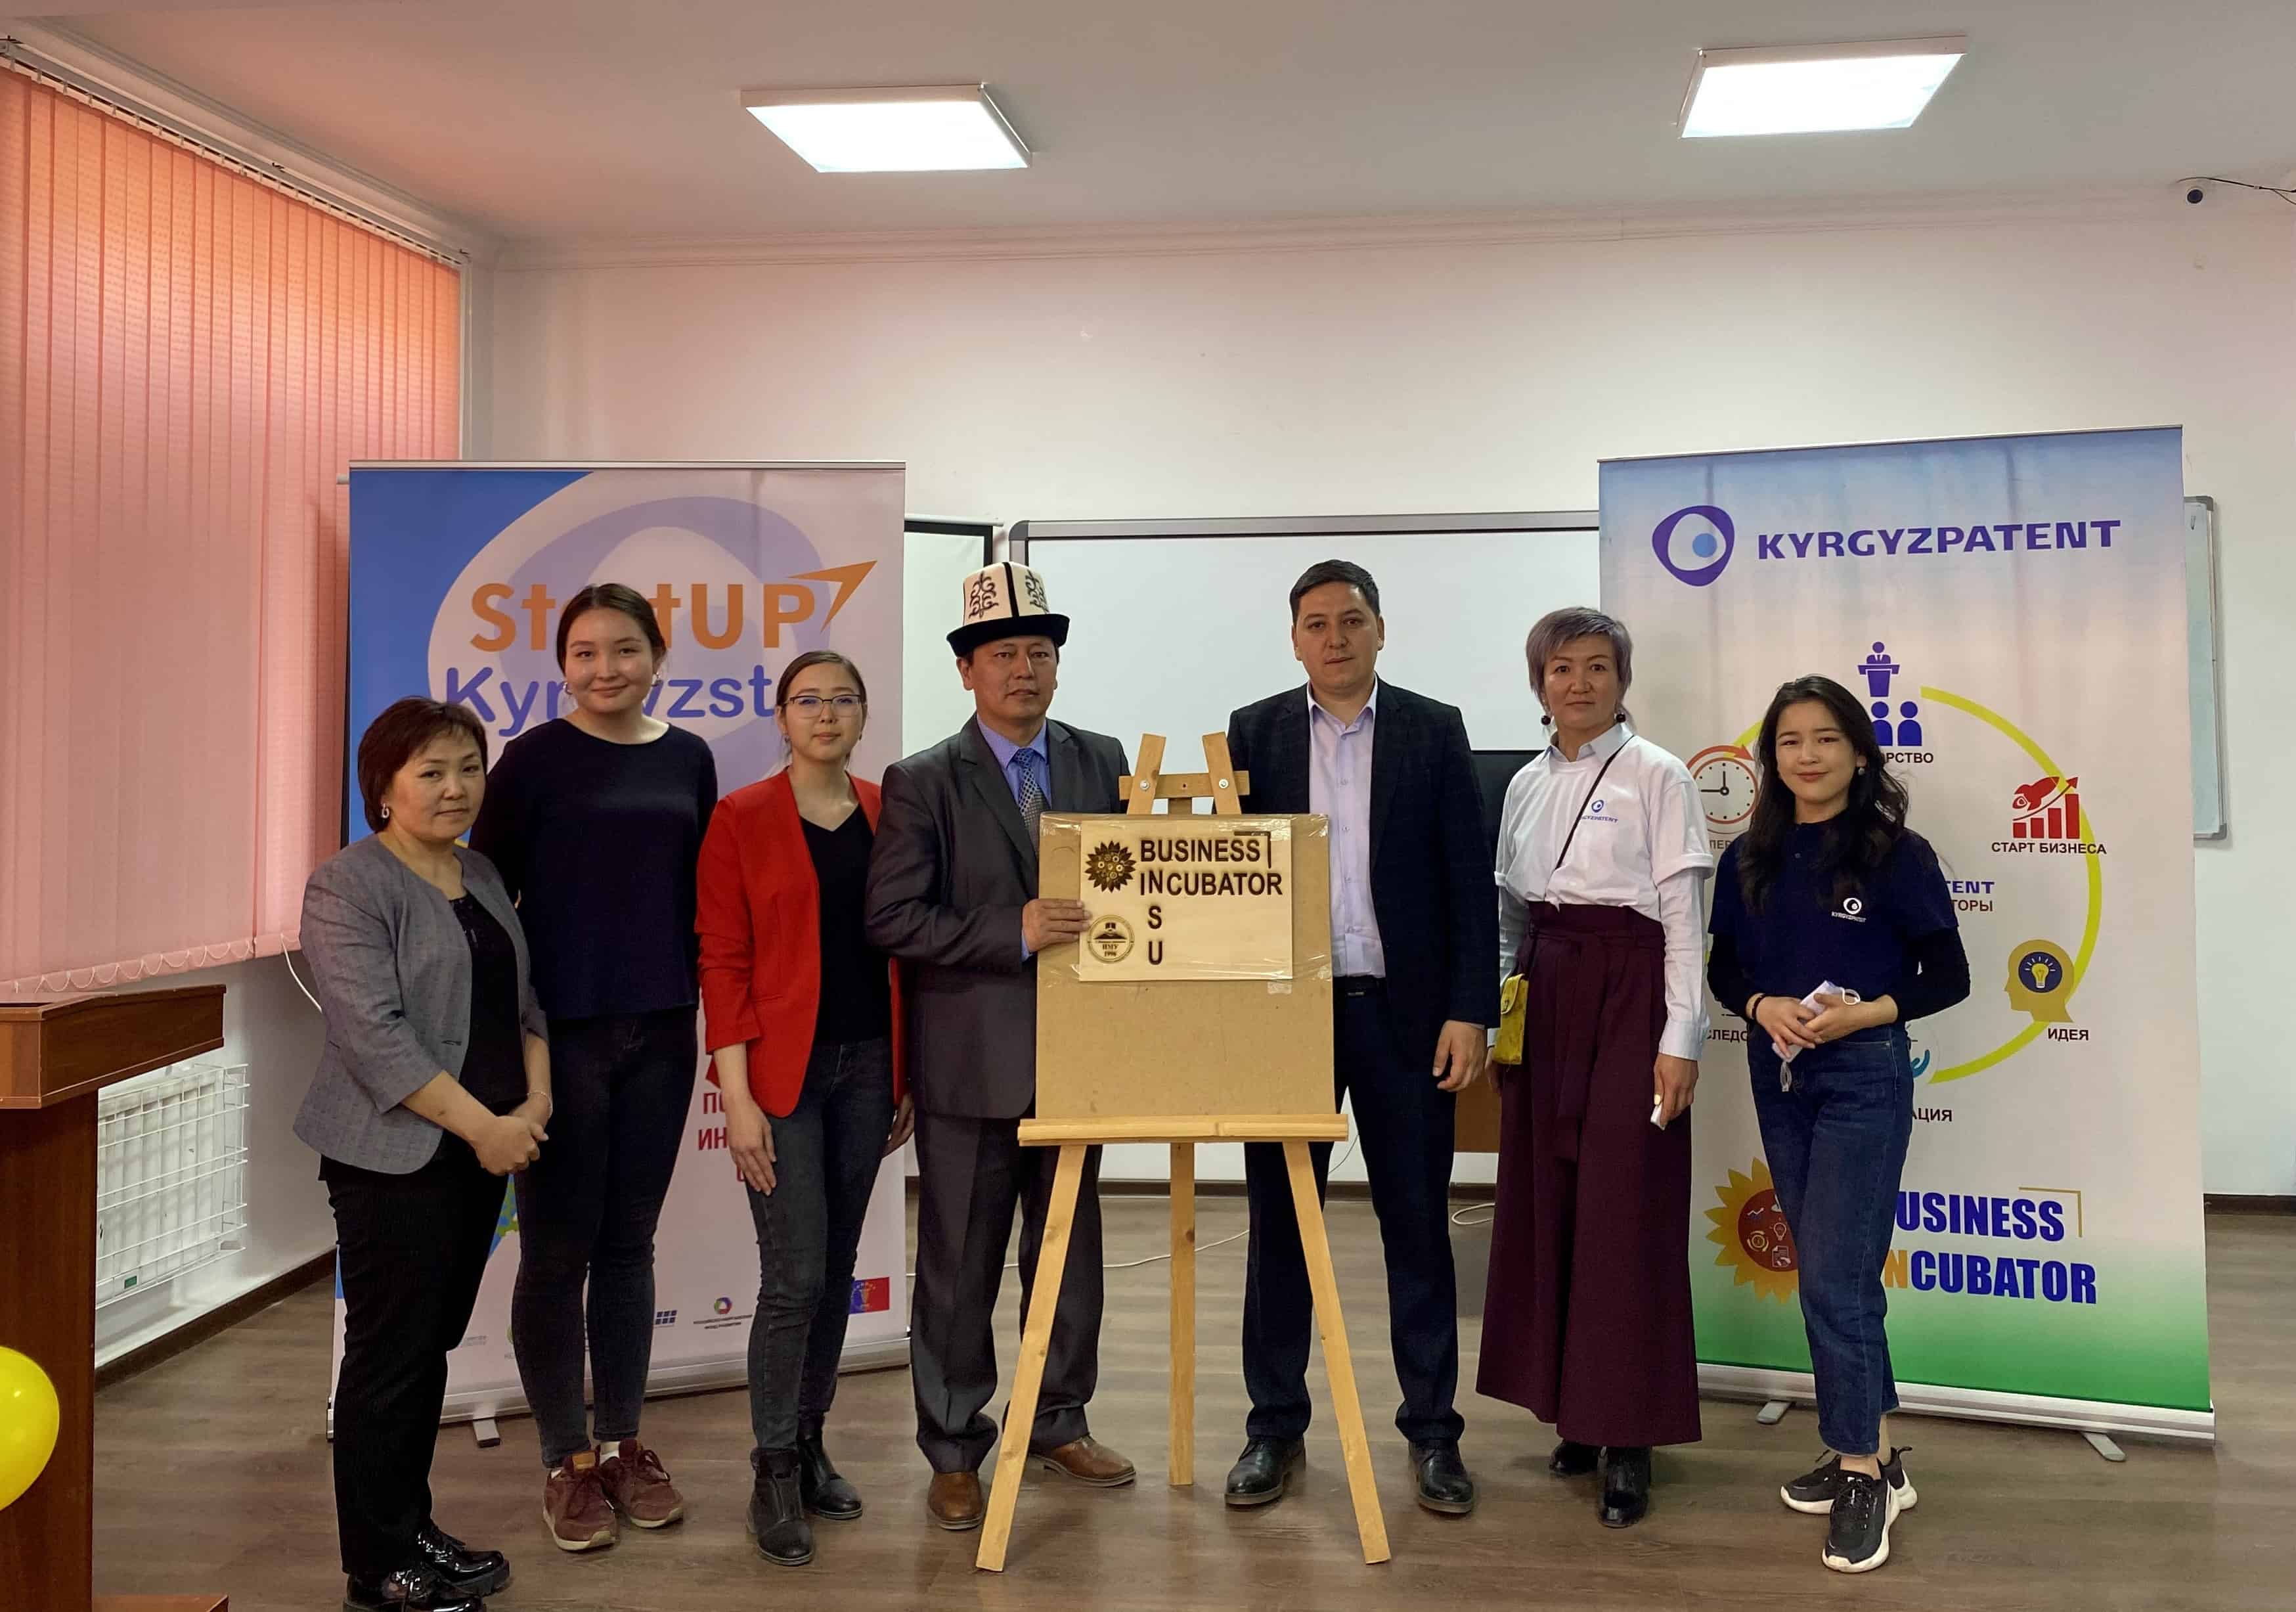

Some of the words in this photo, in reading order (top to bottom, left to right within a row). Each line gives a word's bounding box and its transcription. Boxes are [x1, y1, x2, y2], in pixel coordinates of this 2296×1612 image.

[1758, 520, 2121, 560] KYRGYZPATENT
[470, 583, 815, 652] SttUP
[1140, 839, 1261, 862] BUSINESS
[1991, 841, 2035, 853] СТАРТ
[2039, 843, 2107, 855] БИЗНЕСА
[1139, 870, 1283, 896] INCUBATOR
[1952, 899, 1993, 912] ОРЫ
[2047, 1027, 2089, 1042] ИДЕЯ
[1896, 1190, 2065, 1242] USINESS
[1884, 1249, 2097, 1305] NCUBATOR
